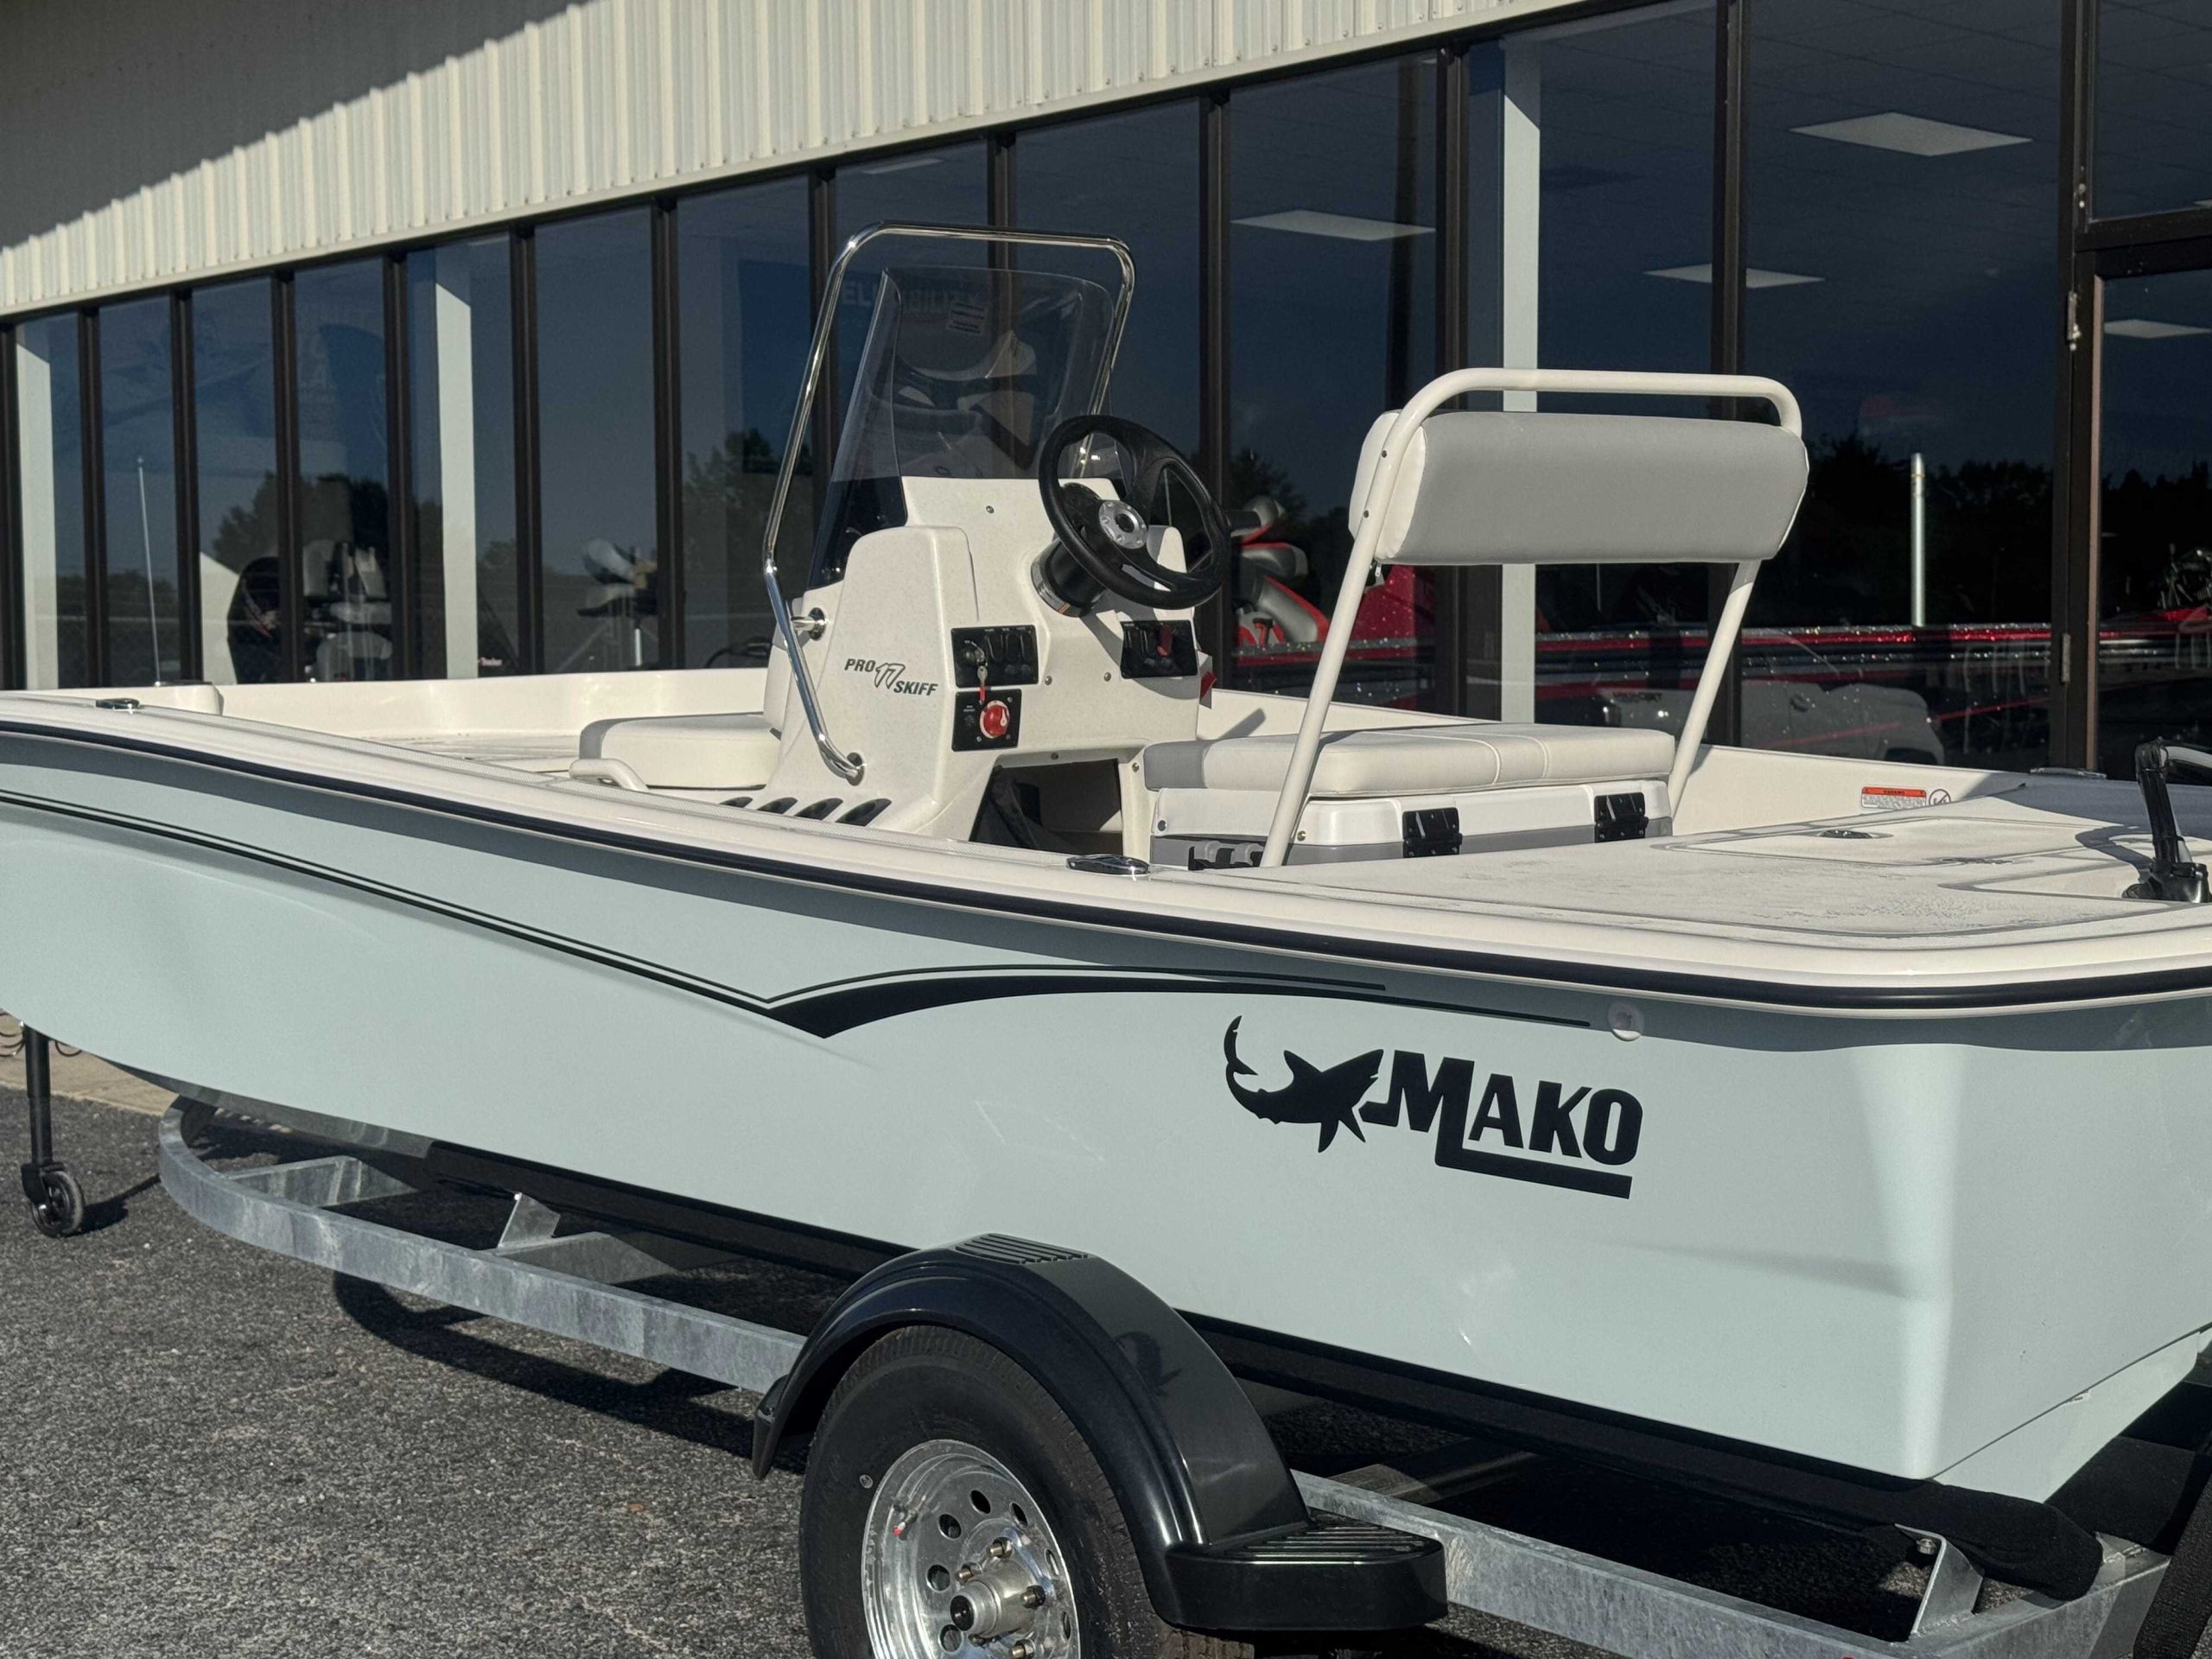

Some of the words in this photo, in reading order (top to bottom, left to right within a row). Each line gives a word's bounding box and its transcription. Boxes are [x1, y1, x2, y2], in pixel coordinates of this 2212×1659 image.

[843, 658, 876, 672] PRO
[874, 662, 906, 690] 17
[893, 680, 939, 696] SKIFF
[1357, 1049, 1643, 1199] MAKO
